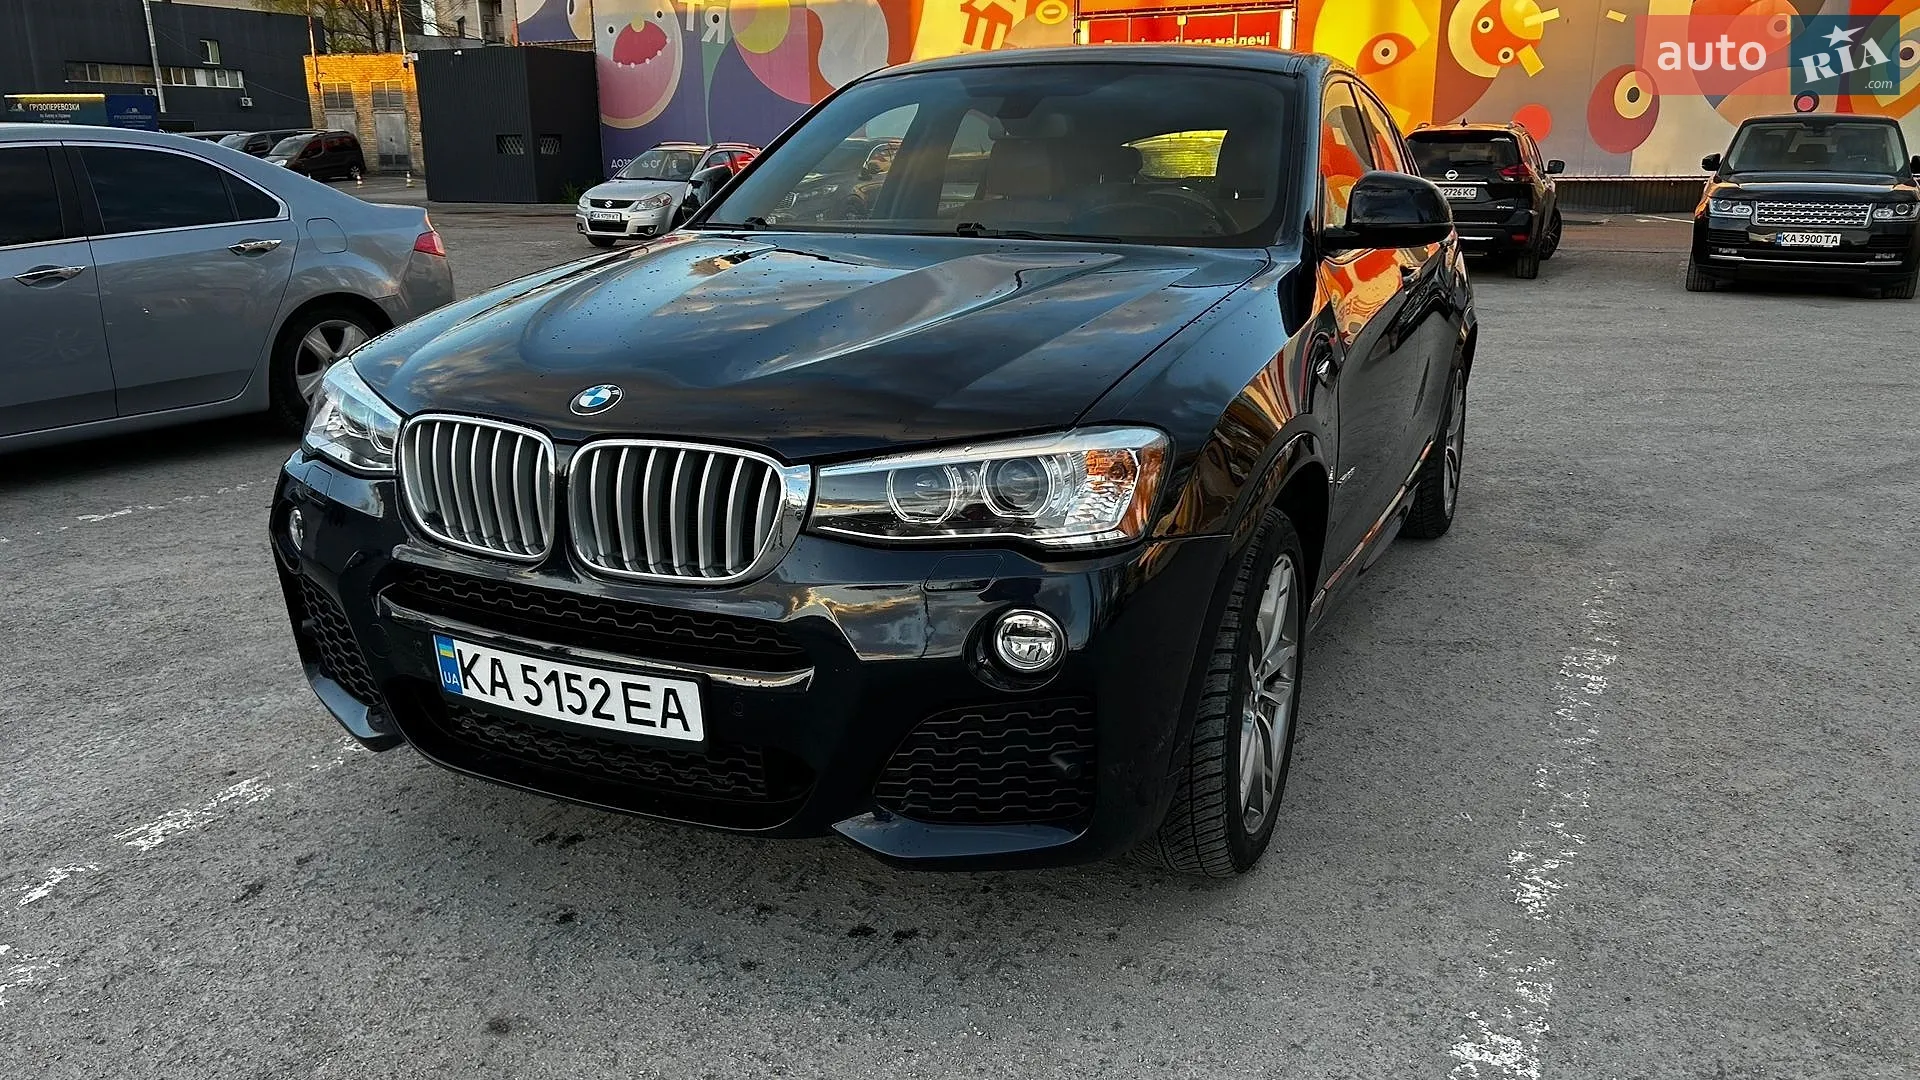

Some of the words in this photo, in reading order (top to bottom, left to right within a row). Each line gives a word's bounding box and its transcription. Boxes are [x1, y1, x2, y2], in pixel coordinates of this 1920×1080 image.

[1783, 234, 1797, 243] KA
[1799, 234, 1823, 243] 3900
[1824, 235, 1838, 244] TA
[443, 671, 460, 686] UA
[457, 648, 515, 701] KA
[520, 663, 616, 722] 5152
[621, 681, 691, 732] EA
